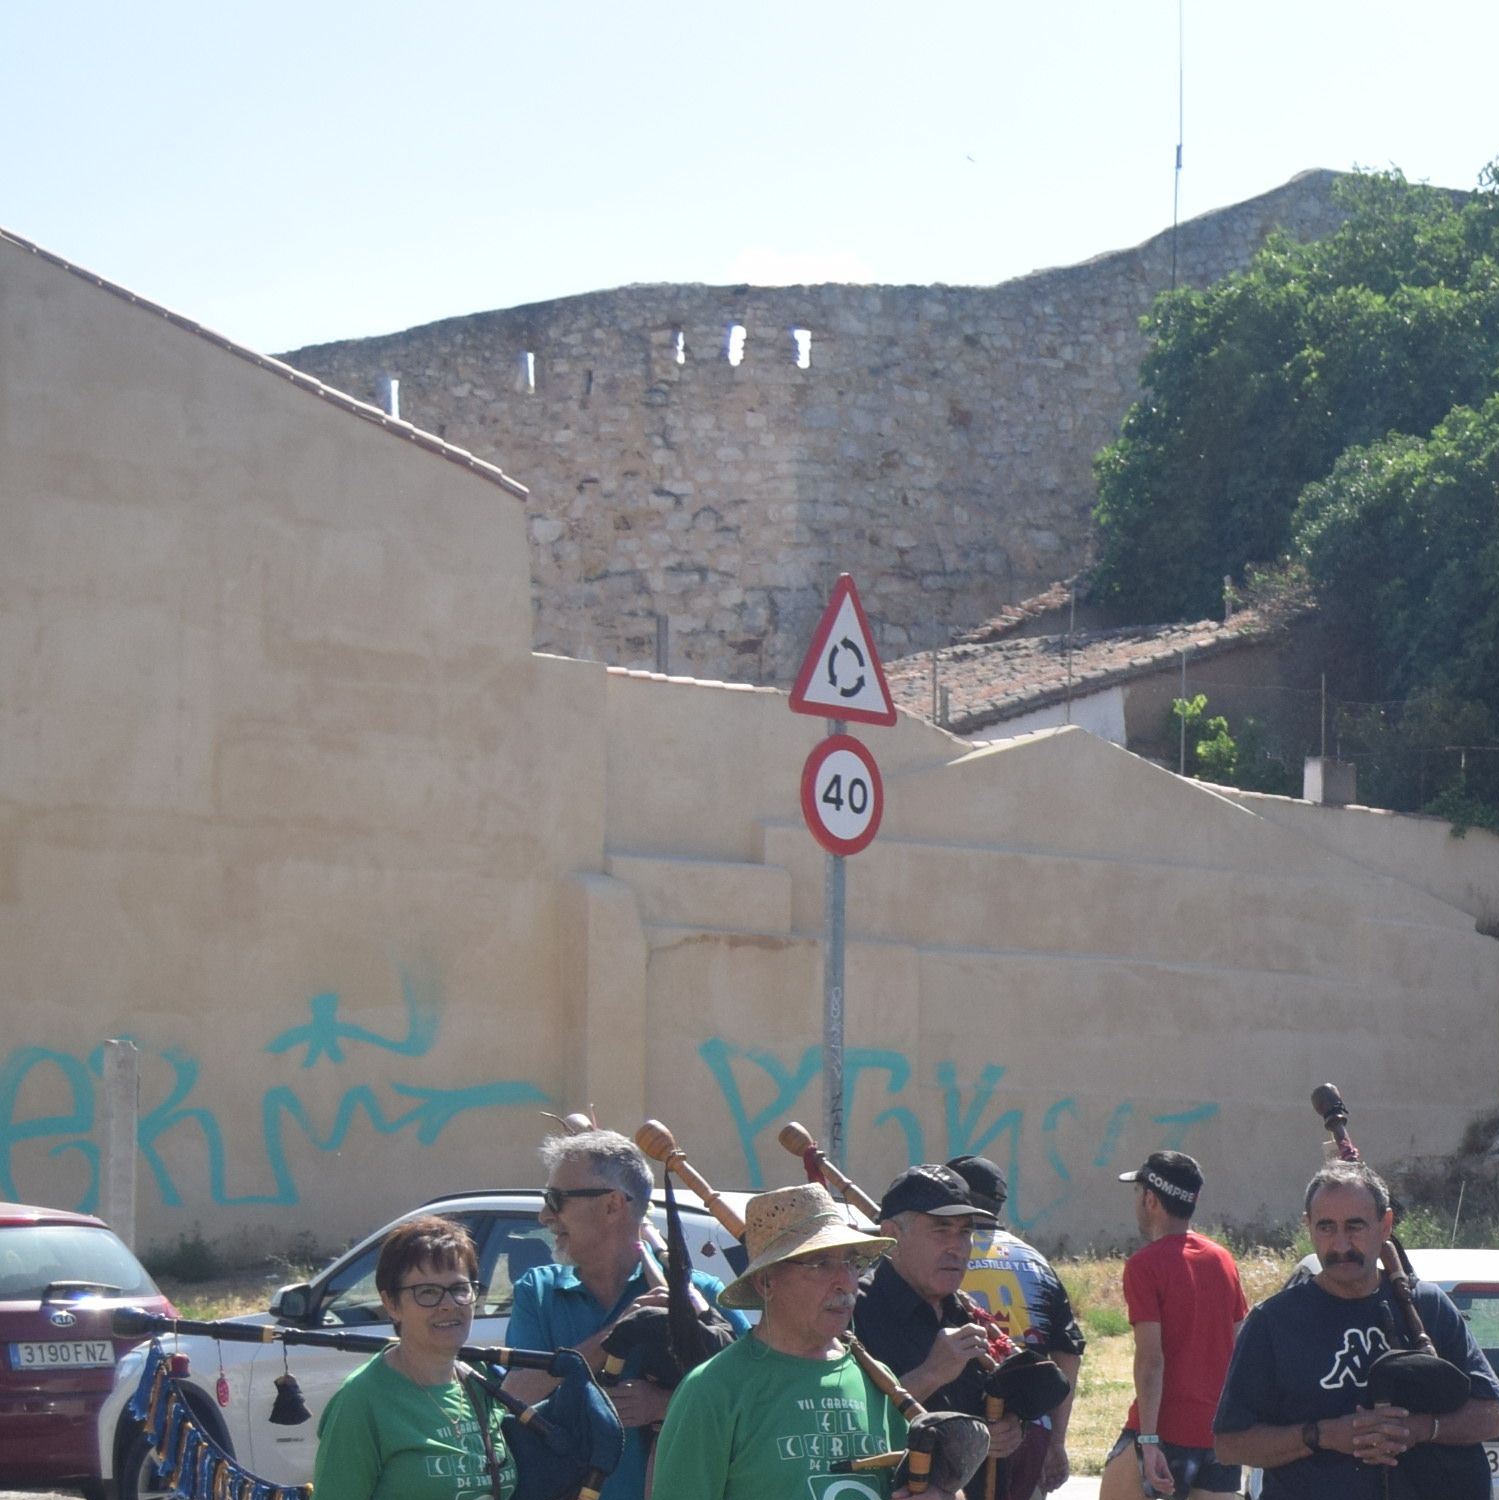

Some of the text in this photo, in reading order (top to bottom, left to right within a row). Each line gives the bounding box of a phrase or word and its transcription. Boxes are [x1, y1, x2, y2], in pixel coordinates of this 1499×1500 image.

[822, 773, 868, 815] 40
[967, 1259, 1012, 1270] CASTILLA
[1013, 1261, 1020, 1271] Y
[24, 1343, 109, 1363] 3190 FNZ
